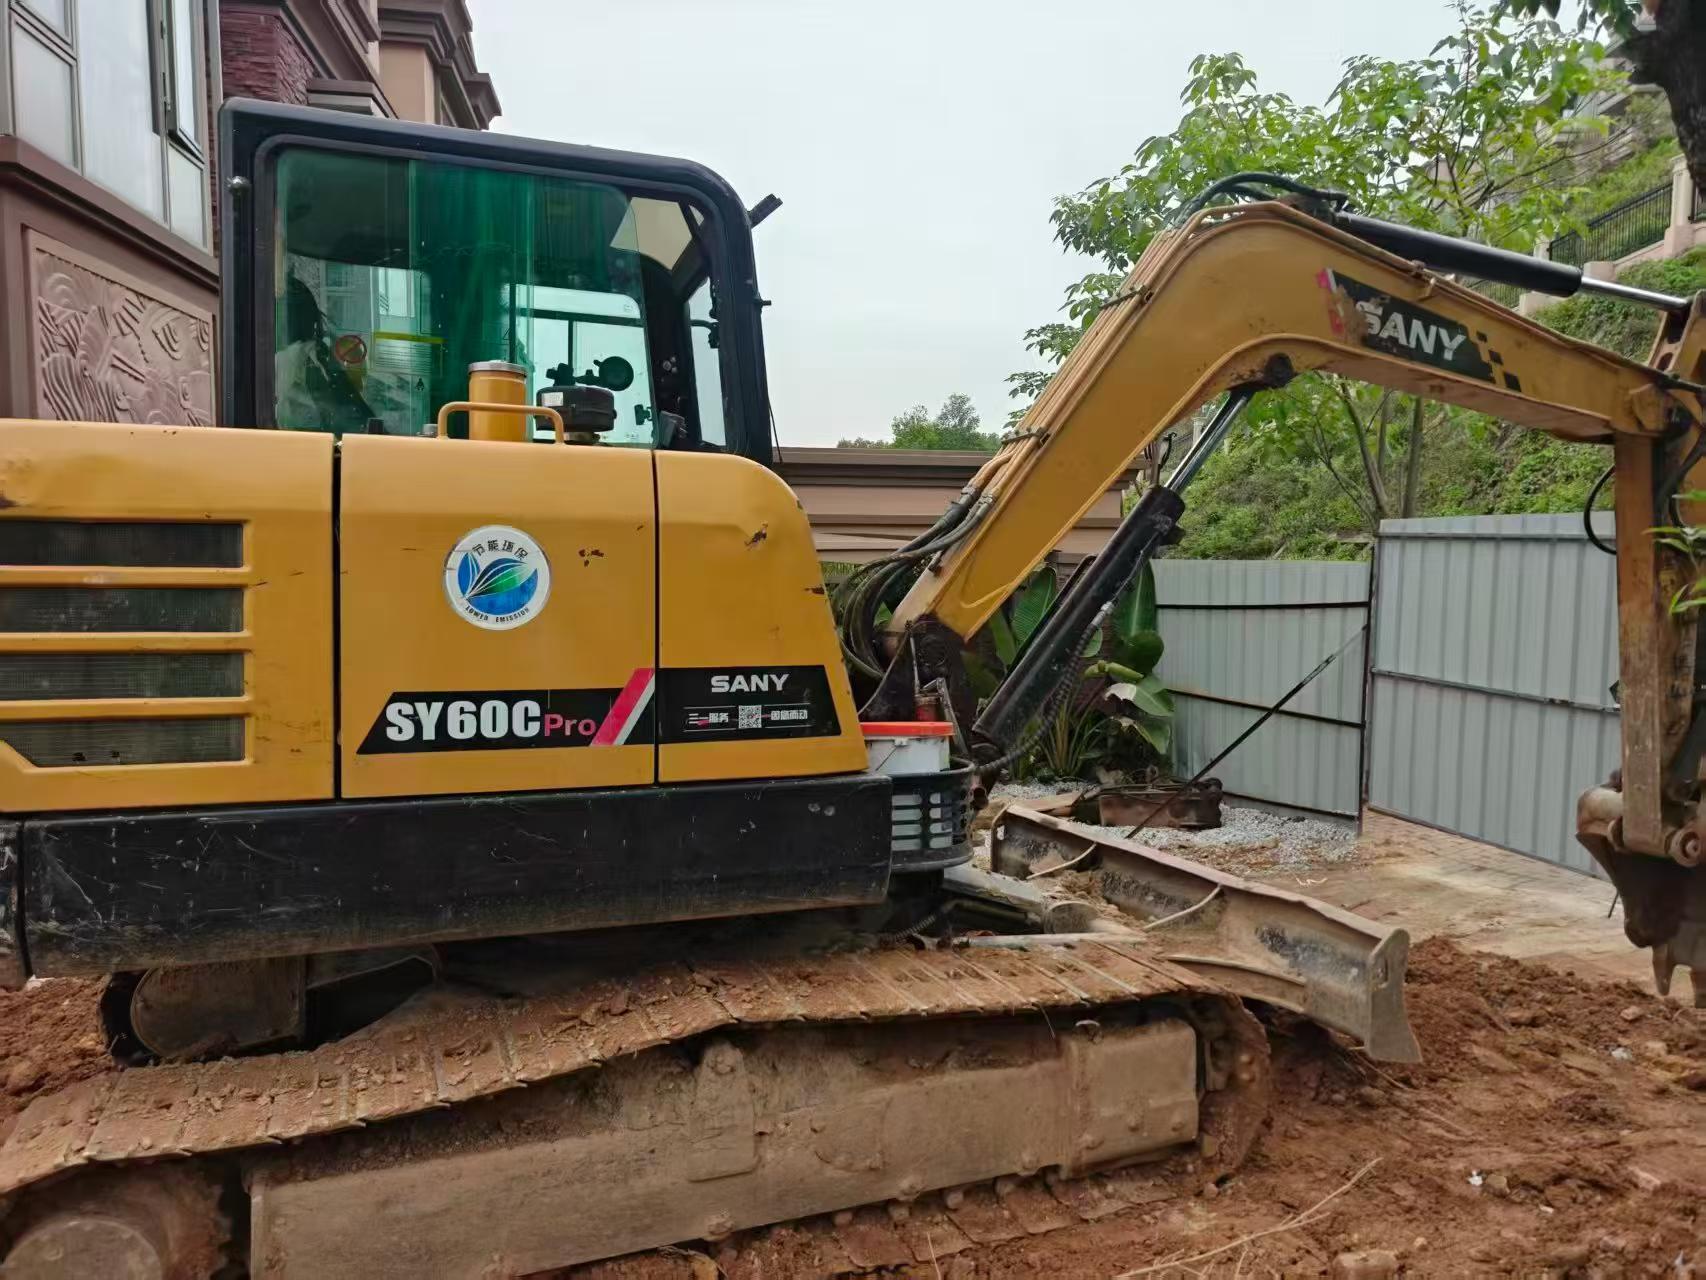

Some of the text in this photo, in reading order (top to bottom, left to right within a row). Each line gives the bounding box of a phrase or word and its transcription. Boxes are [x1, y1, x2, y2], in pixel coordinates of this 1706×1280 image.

[1355, 300, 1466, 361] SANY
[465, 605, 530, 623] LOWER EMISSION
[710, 673, 790, 693] SANY
[385, 699, 597, 742] SY60C Pro
